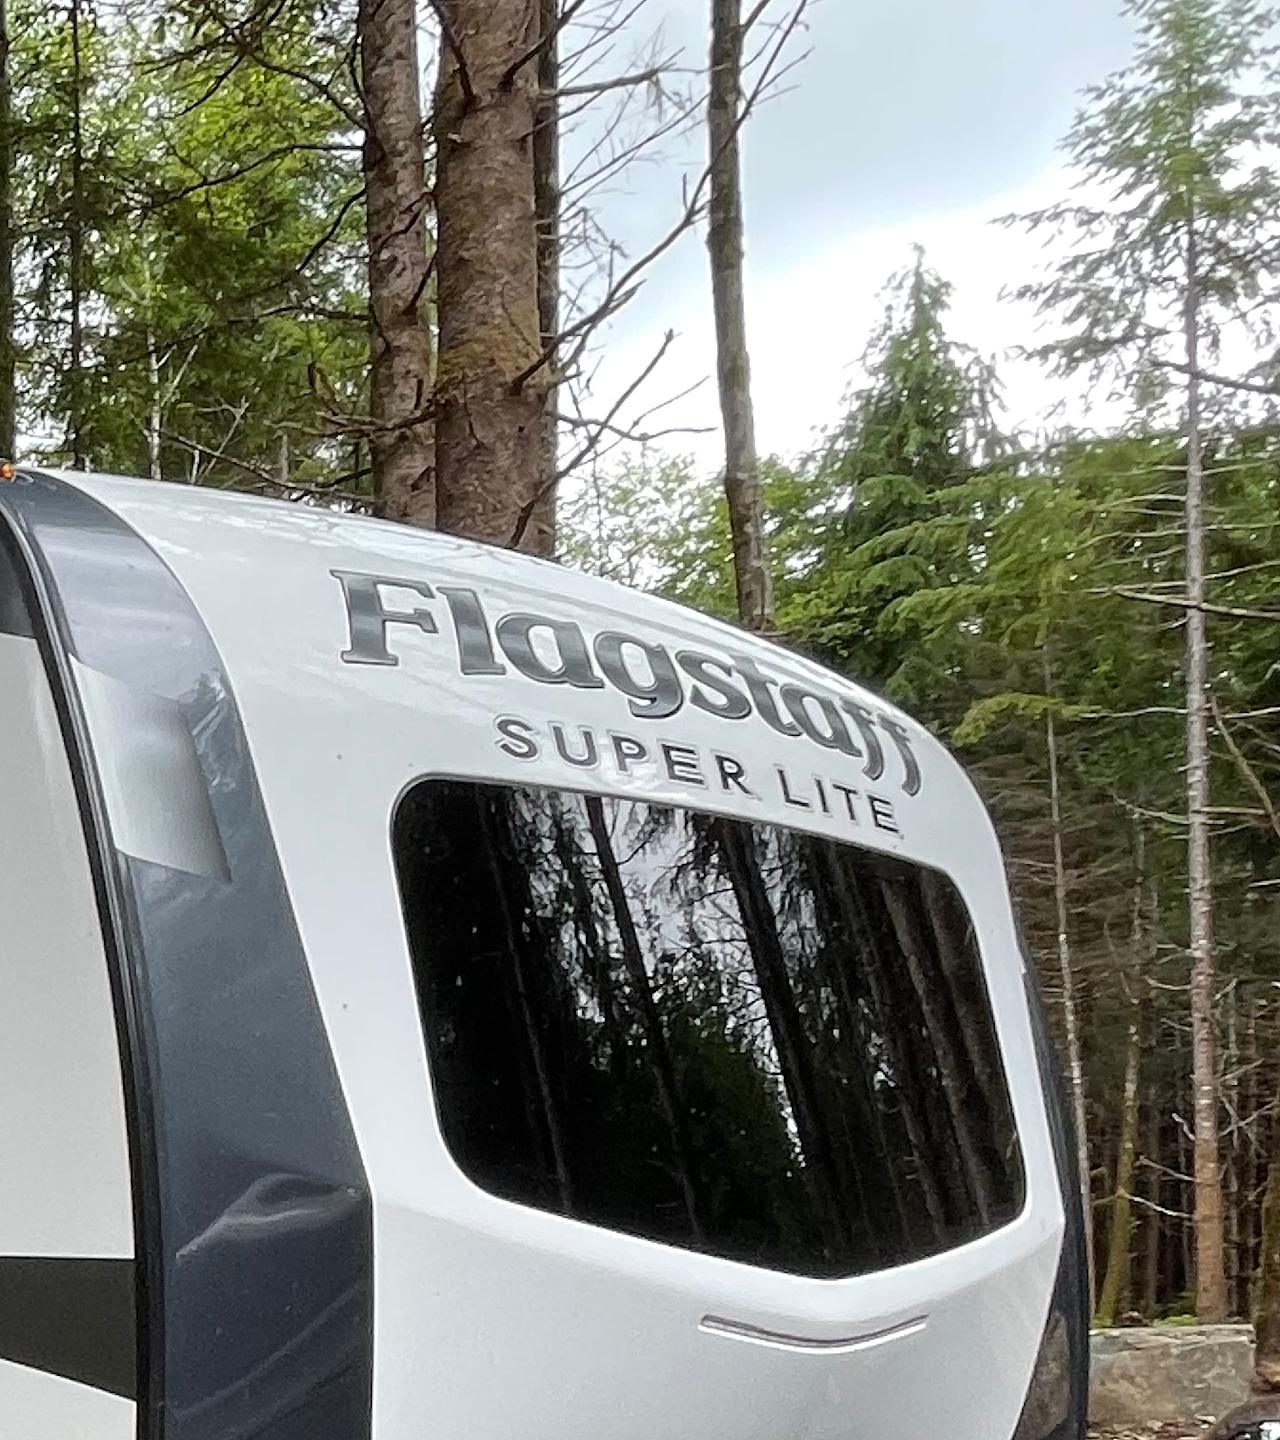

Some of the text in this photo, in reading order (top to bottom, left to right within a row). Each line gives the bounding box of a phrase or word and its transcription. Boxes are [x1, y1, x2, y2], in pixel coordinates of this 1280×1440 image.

[330, 568, 922, 797] Flagstaff
[496, 716, 900, 833] SUPER LITE
